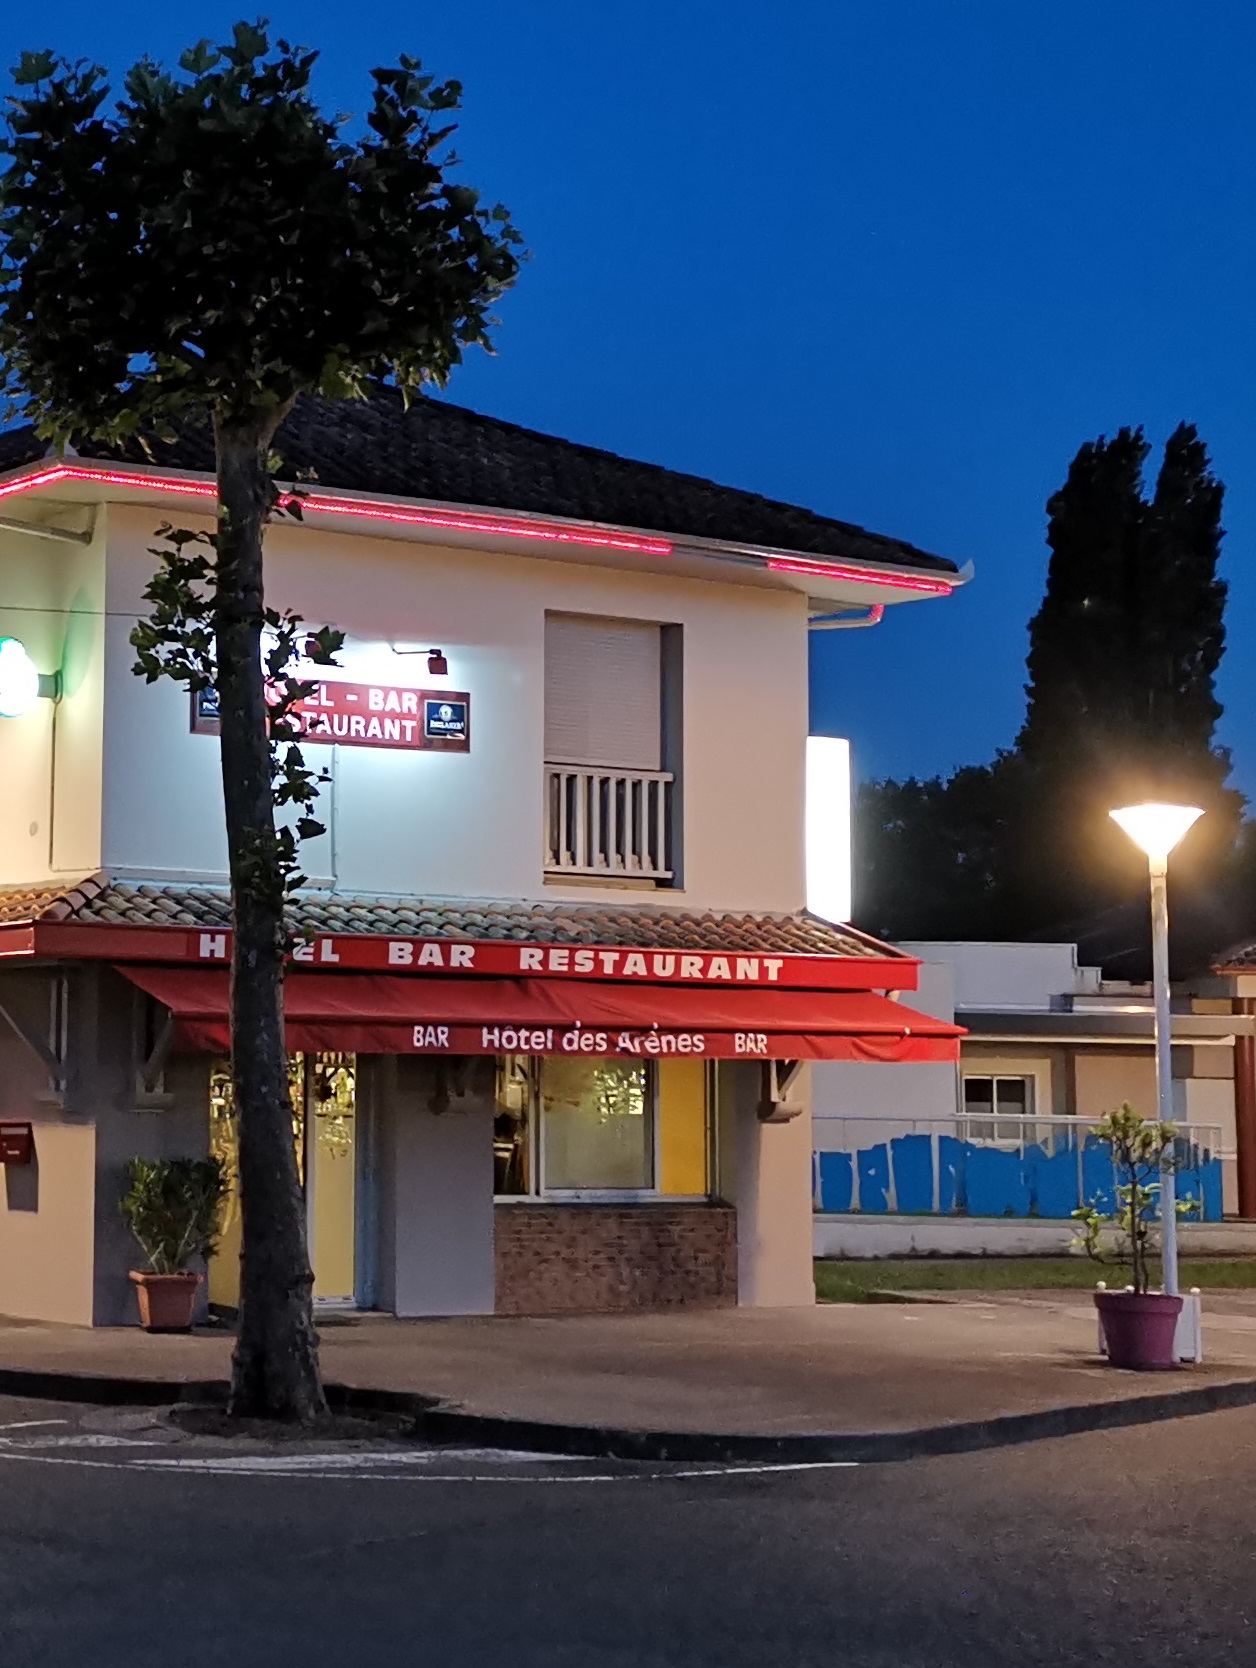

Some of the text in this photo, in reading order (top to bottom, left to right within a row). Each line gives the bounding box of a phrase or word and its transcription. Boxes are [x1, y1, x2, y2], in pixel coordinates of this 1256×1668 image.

[368, 688, 418, 714] BAR
[199, 934, 784, 981] HEL BAR RESTAURANT
[413, 1025, 769, 1055] BAR Hôtel des Arènes BAR
